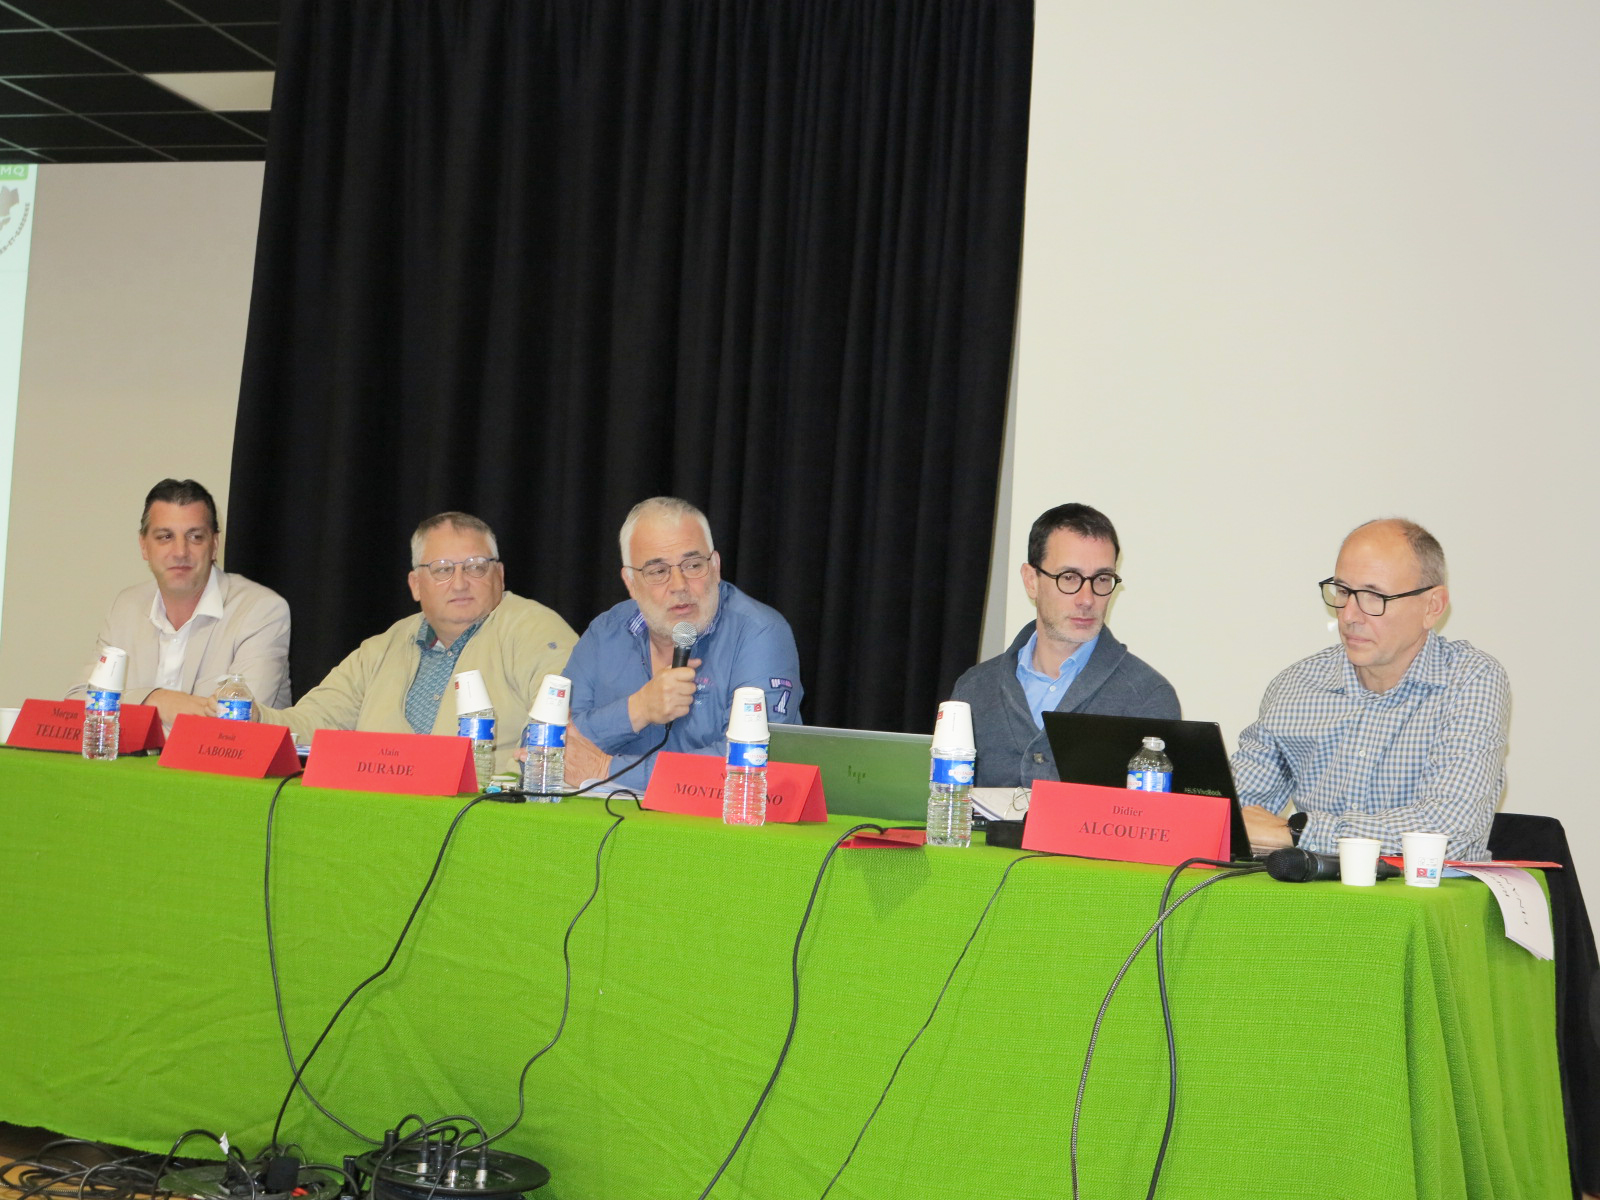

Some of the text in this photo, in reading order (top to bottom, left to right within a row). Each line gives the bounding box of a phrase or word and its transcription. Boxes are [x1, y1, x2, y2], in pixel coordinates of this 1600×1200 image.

[52, 707, 78, 719] Morgan
[36, 723, 81, 741] TELLIER
[198, 744, 245, 759] LABORDE
[379, 748, 399, 757] Alain
[357, 761, 415, 777] DURADE
[1112, 805, 1144, 817] Didier
[1079, 821, 1171, 843] ALCOUFFE
